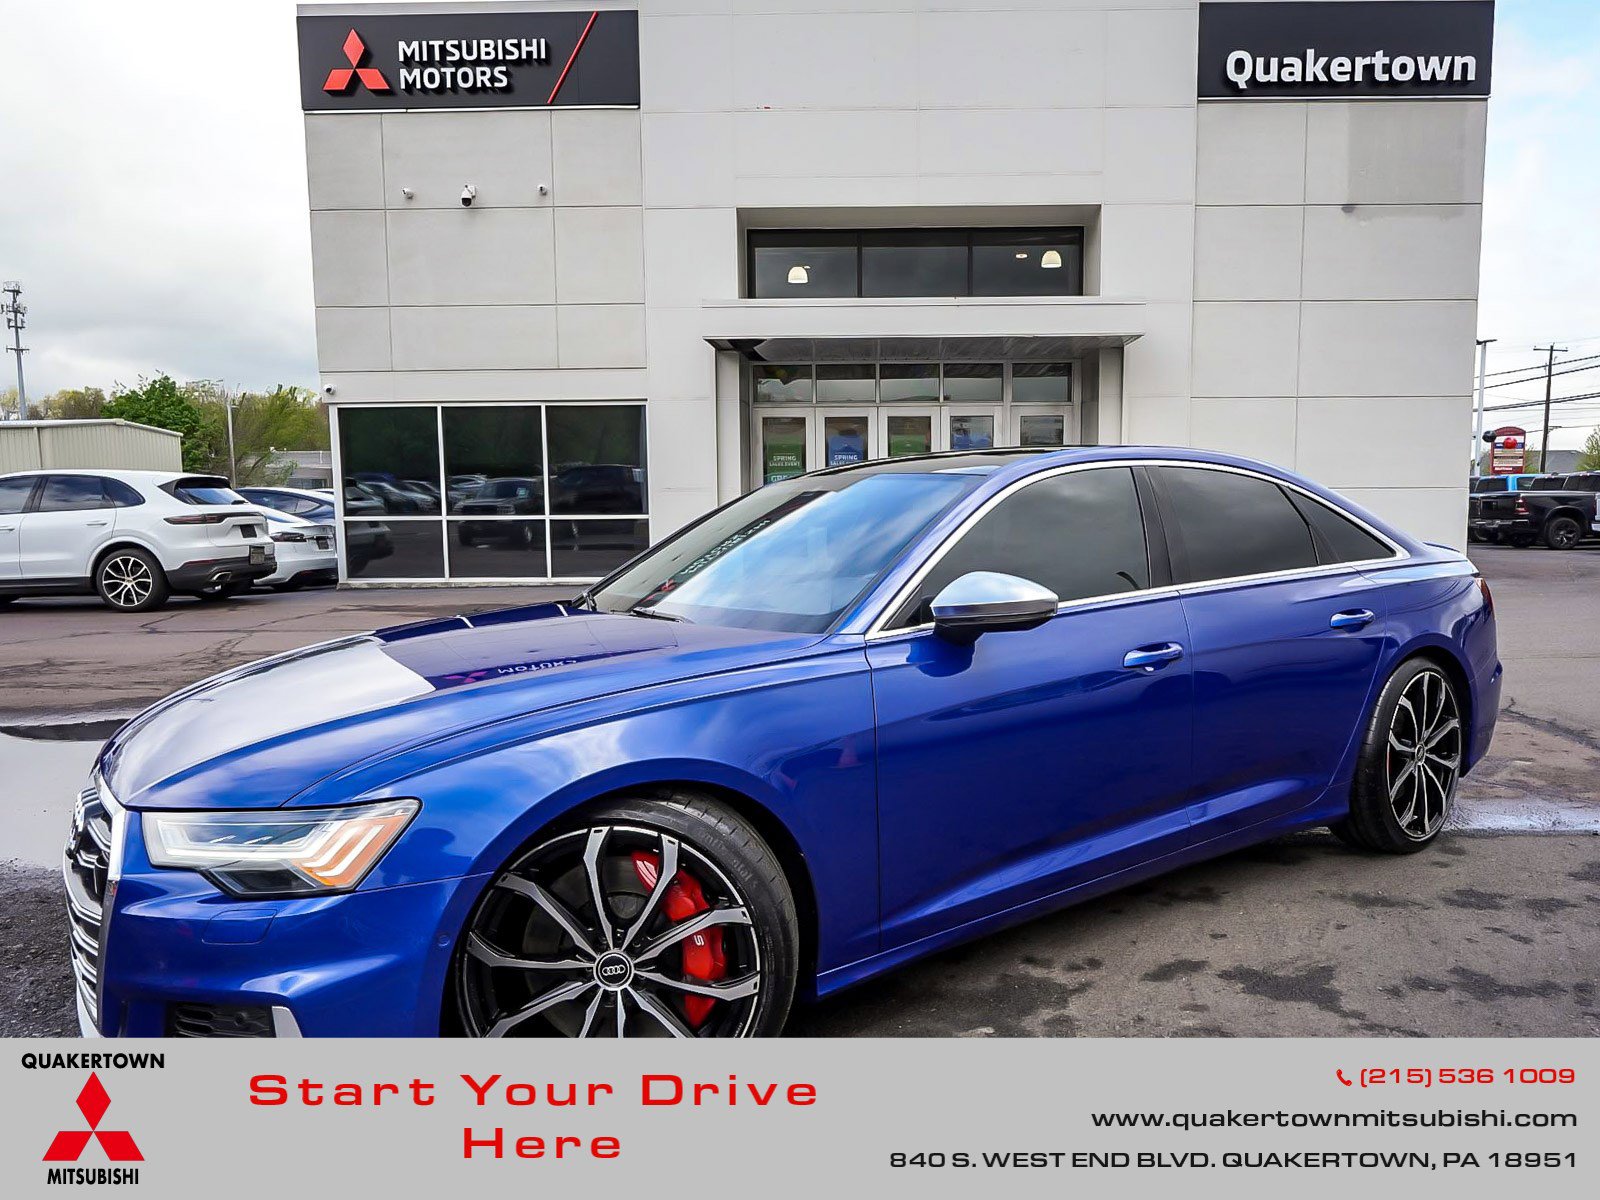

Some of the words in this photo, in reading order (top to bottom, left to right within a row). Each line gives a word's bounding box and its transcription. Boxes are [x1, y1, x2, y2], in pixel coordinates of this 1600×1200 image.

[398, 38, 547, 62] MITSUBISHI
[400, 66, 508, 90] MOTORS
[1226, 48, 1477, 89] Quakertown
